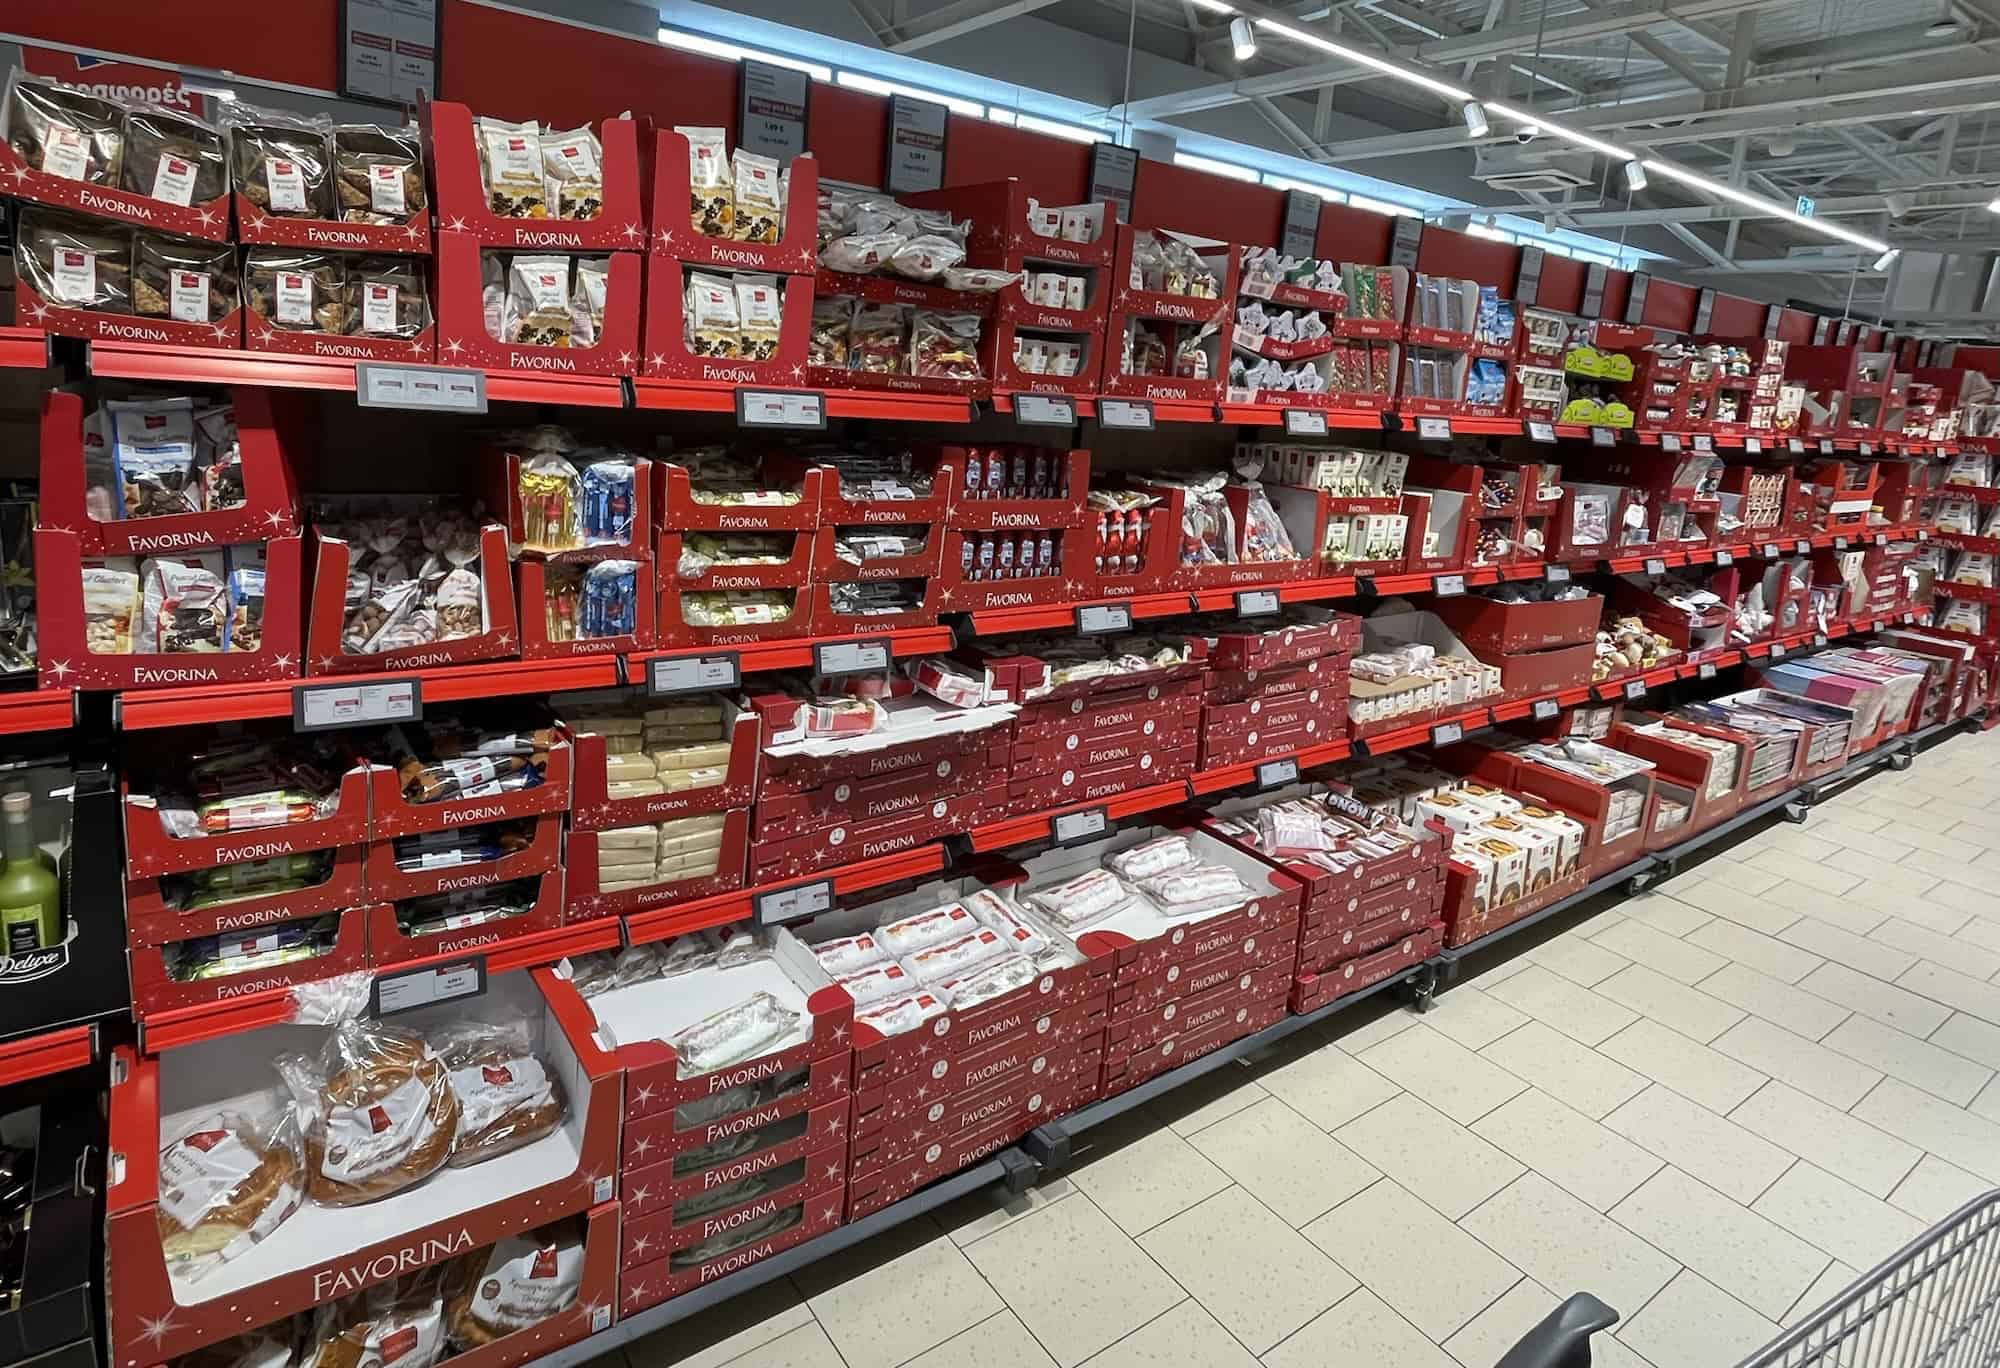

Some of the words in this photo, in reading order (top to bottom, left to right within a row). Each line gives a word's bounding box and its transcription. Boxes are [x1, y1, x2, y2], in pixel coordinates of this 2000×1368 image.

[81, 191, 151, 219] FAVORINA
[309, 228, 368, 244] FAVORINA
[515, 228, 582, 246] FAVORINA
[712, 246, 764, 265] FAVORINA
[1046, 245, 1080, 260] FAVORINA
[1155, 302, 1194, 318] FAVORINA
[1038, 314, 1072, 327] FAVORINA
[100, 321, 168, 341] FAVORINA
[315, 342, 374, 358] FAVORINA
[511, 352, 575, 370] FAVORINA
[704, 366, 756, 382] FAVORINA
[1146, 384, 1186, 399] FAVORINA
[720, 515, 768, 528] FAVORINA
[864, 511, 906, 521] FAVORINA
[992, 512, 1040, 526] FAVORINA
[129, 532, 214, 550] FAVORINA
[712, 576, 760, 587] FAVORINA
[858, 568, 900, 577] FAVORINA
[986, 592, 1032, 605] FAVORINA
[854, 624, 896, 633] FAVORINA
[572, 642, 616, 652] FAVORINA
[712, 634, 760, 645] FAVORINA
[385, 652, 452, 669] FAVORINA
[134, 667, 218, 682] FAVORINA
[1094, 713, 1132, 726] FAVORINA
[870, 752, 922, 772] FAVORINA
[1090, 748, 1129, 762] FAVORINA
[1086, 783, 1126, 798] FAVORINA
[647, 799, 688, 813] FAVORINA
[868, 794, 920, 815] FAVORINA
[443, 806, 506, 824] FAVORINA
[216, 841, 292, 862] FAVORINA
[863, 835, 914, 856] FAVORINA
[438, 873, 499, 890] FAVORINA
[216, 907, 290, 929] FAVORINA
[438, 934, 500, 953] FAVORINA
[1196, 934, 1232, 954] FAVORINA
[0, 952, 59, 976] Deluxe
[217, 976, 291, 998] FAVORINA
[1190, 970, 1228, 991] FAVORINA
[1186, 1006, 1225, 1028] FAVORINA
[968, 1016, 1021, 1044] FAVORINA
[708, 1060, 783, 1093] FAVORINA
[966, 1056, 1018, 1086] FAVORINA
[961, 1096, 1012, 1126] FAVORINA
[707, 1108, 780, 1142] FAVORINA
[959, 1135, 1010, 1166] FAVORINA
[704, 1153, 777, 1189] FAVORINA
[704, 1200, 776, 1238] FAVORINA
[313, 1228, 474, 1301] FAVORINA
[701, 1244, 773, 1282] FAVORINA
